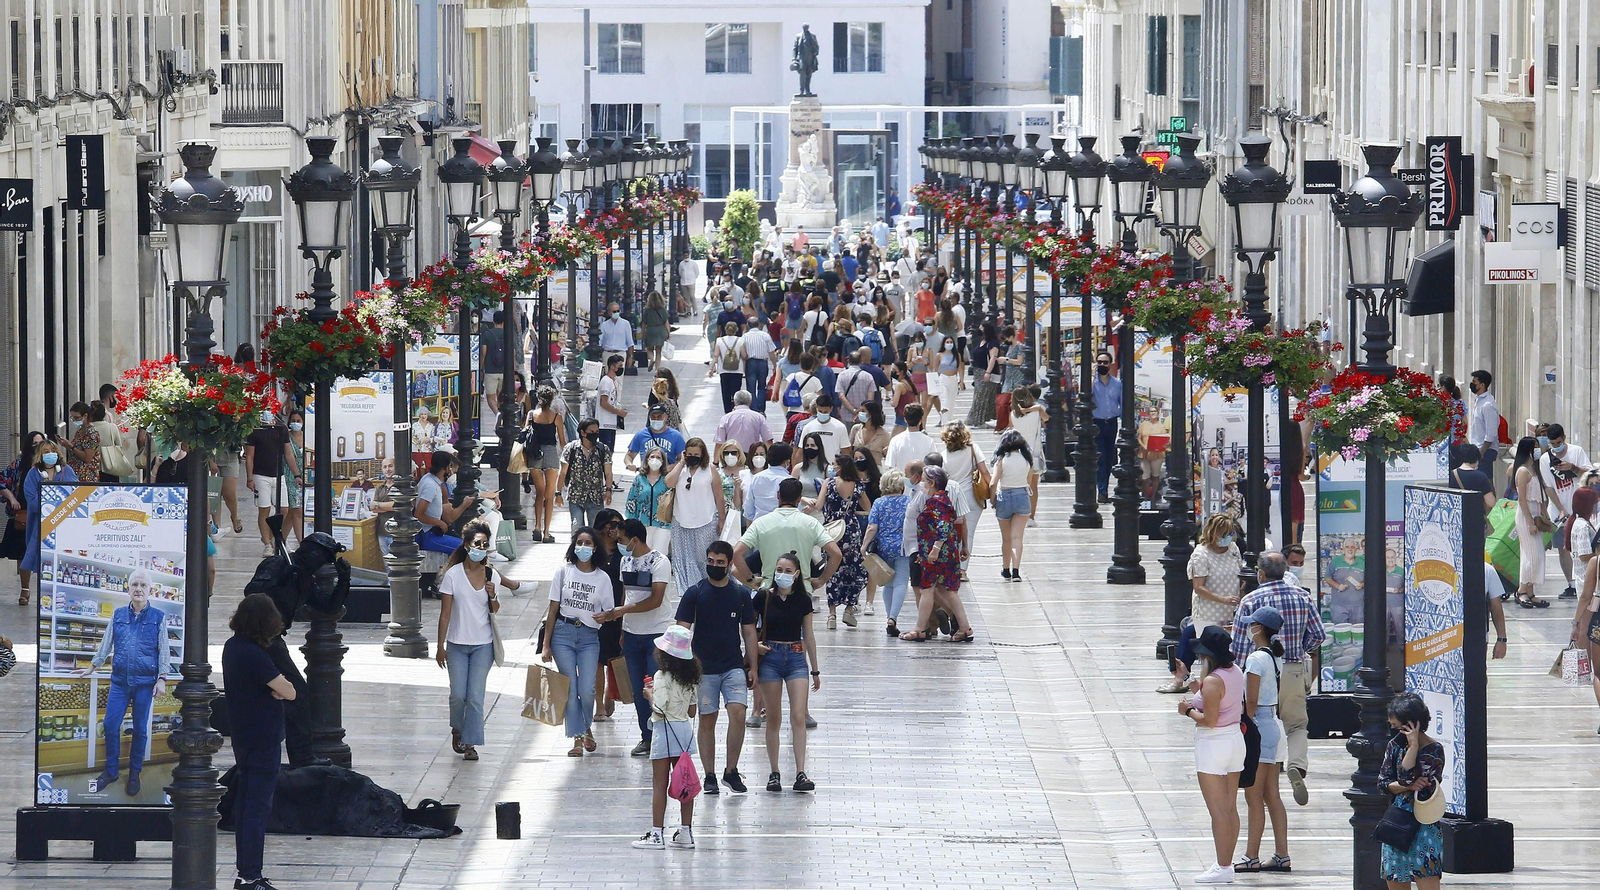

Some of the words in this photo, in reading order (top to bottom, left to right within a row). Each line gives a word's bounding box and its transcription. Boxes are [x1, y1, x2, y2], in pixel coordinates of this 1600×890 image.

[1401, 173, 1425, 182] Bersh
[1429, 142, 1446, 226] PRIMOR
[1, 187, 30, 211] -Ban
[1284, 196, 1315, 205] NDORA
[1516, 221, 1555, 234] COS
[1490, 269, 1526, 280] PIKOLINOS
[50, 507, 68, 525] DESDE
[568, 581, 580, 591] LATE
[581, 583, 596, 593] NIGHT
[572, 590, 589, 601] PHONE
